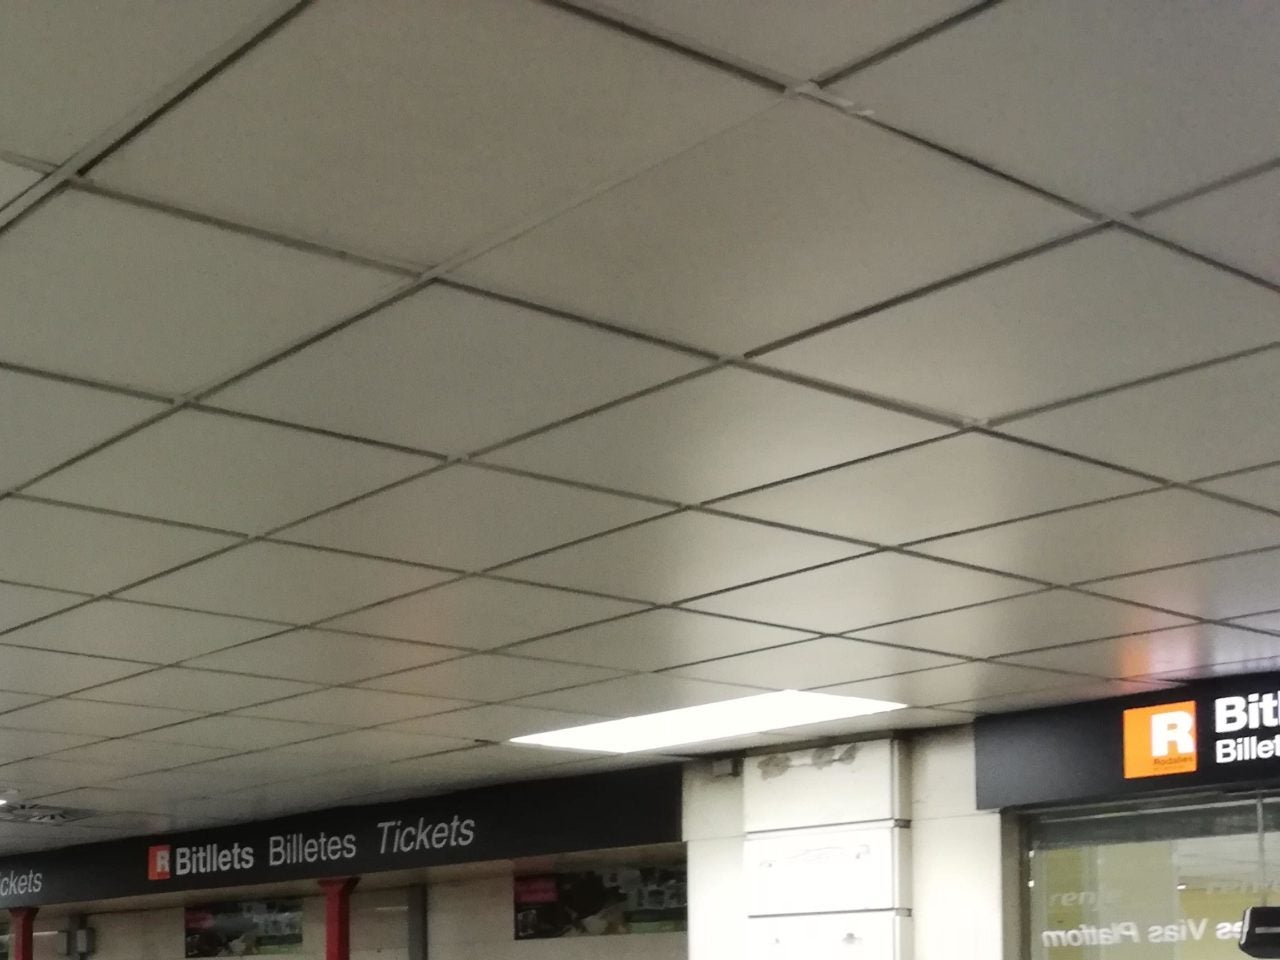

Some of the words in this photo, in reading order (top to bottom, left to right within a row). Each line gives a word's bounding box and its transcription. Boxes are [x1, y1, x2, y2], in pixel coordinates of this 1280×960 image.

[1151, 711, 1195, 757] R
[175, 843, 254, 875] Bitllets
[269, 832, 357, 866] Billetes
[377, 814, 476, 854] Tickets
